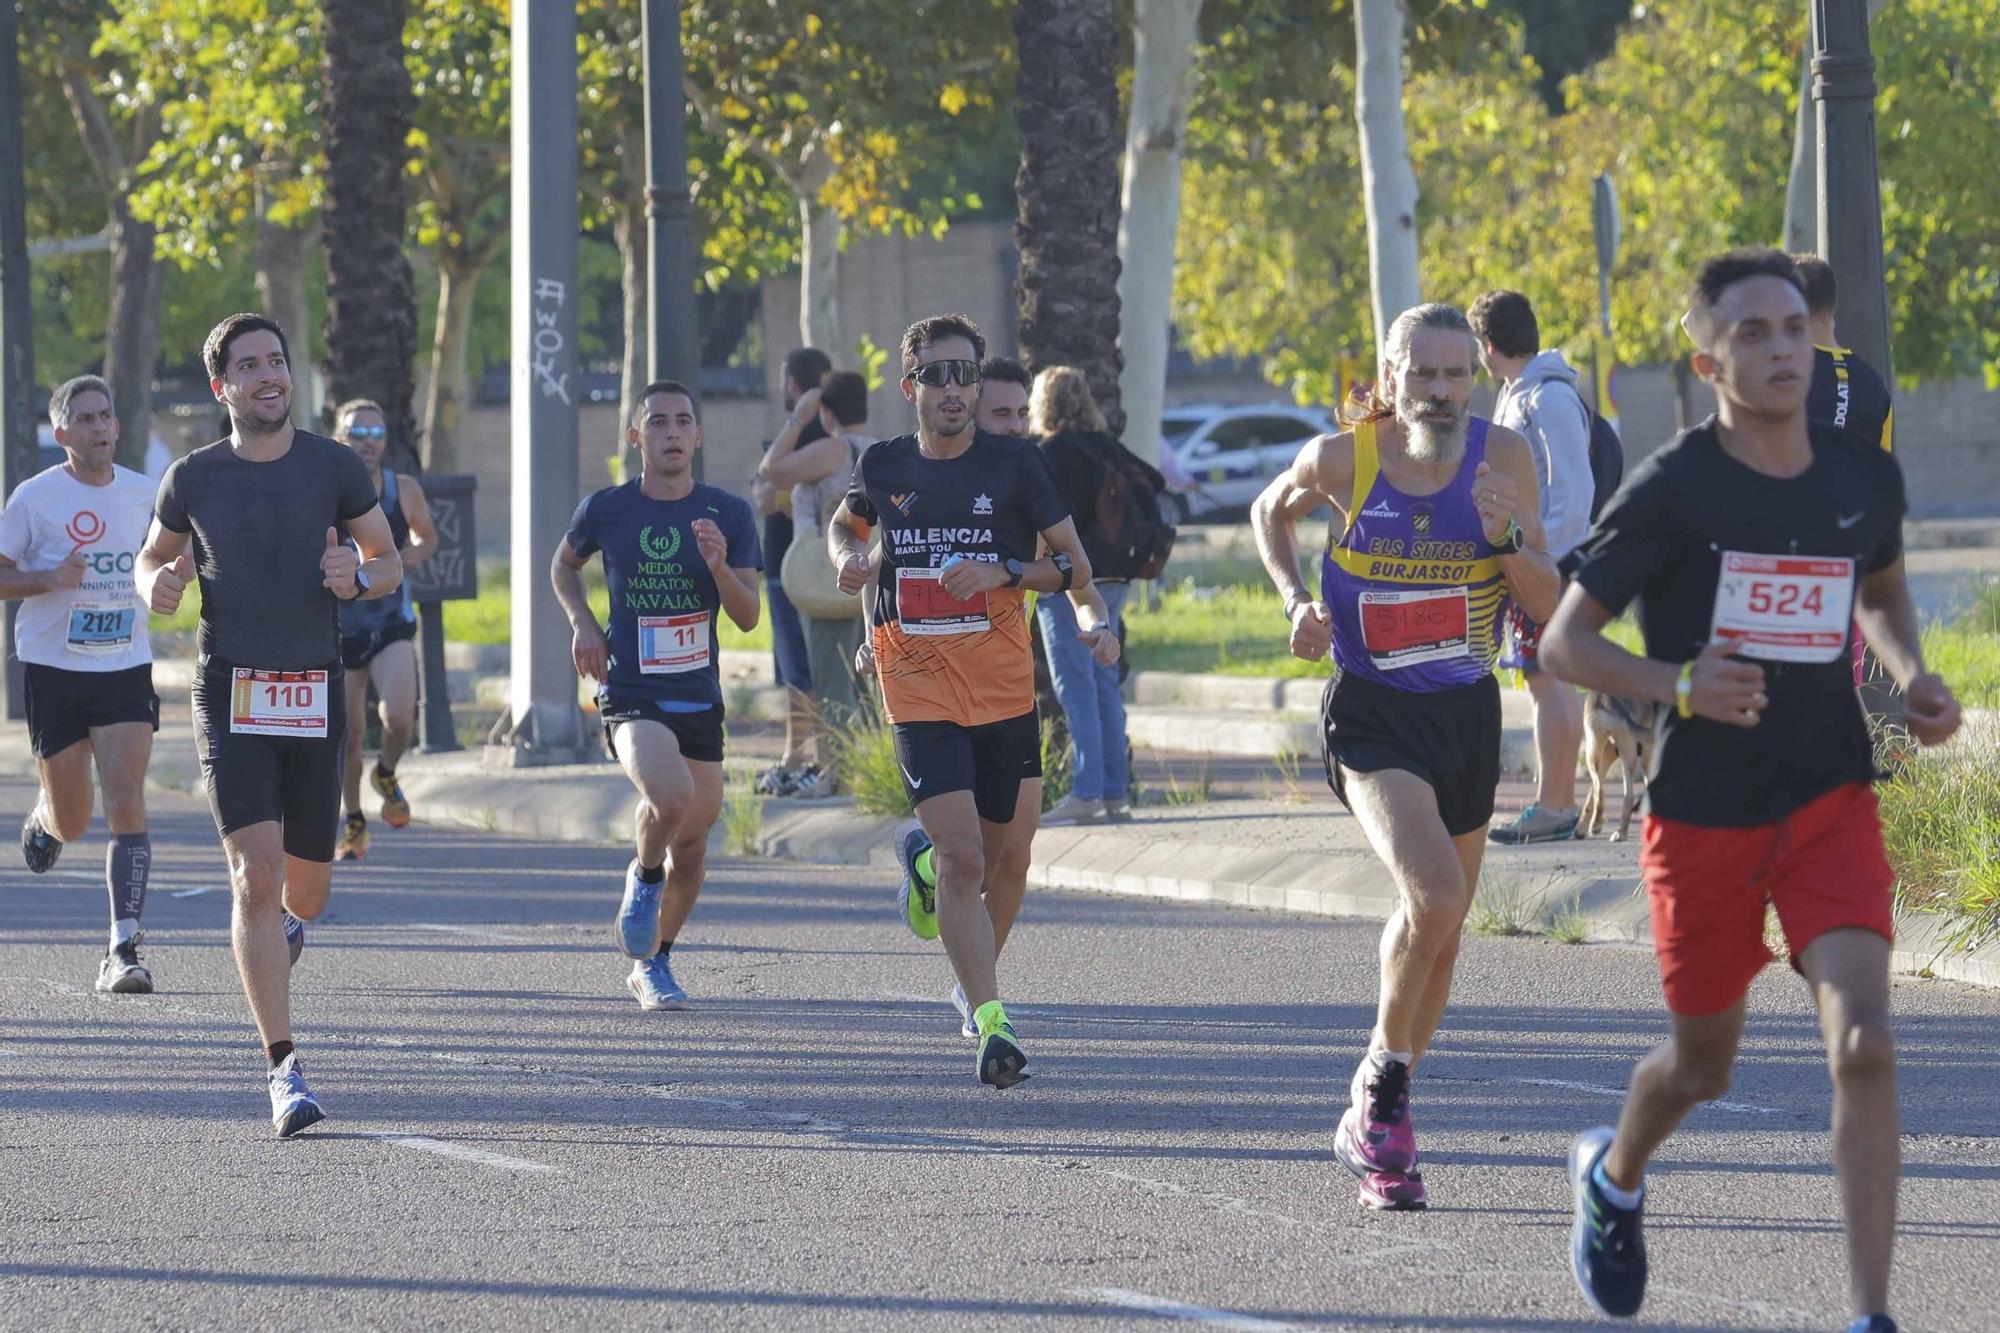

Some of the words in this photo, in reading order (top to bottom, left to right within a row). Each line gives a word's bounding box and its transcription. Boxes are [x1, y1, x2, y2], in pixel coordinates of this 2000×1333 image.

[1361, 509, 1400, 518] MERCURY
[651, 537, 670, 550] 40
[891, 528, 993, 545] VALENCIA
[895, 545, 927, 555] MAKES
[930, 544, 952, 553] YOU
[1370, 537, 1404, 558] ELS
[1411, 541, 1476, 560] SITGES
[637, 562, 683, 575] MEDIO
[1369, 561, 1475, 580] BURJASSOT
[627, 577, 694, 590] MARATON
[626, 593, 702, 609] NAVAJAS
[1748, 582, 1823, 616] 524
[82, 612, 122, 633] 2121
[674, 626, 695, 647] 11
[264, 686, 313, 708] 110
